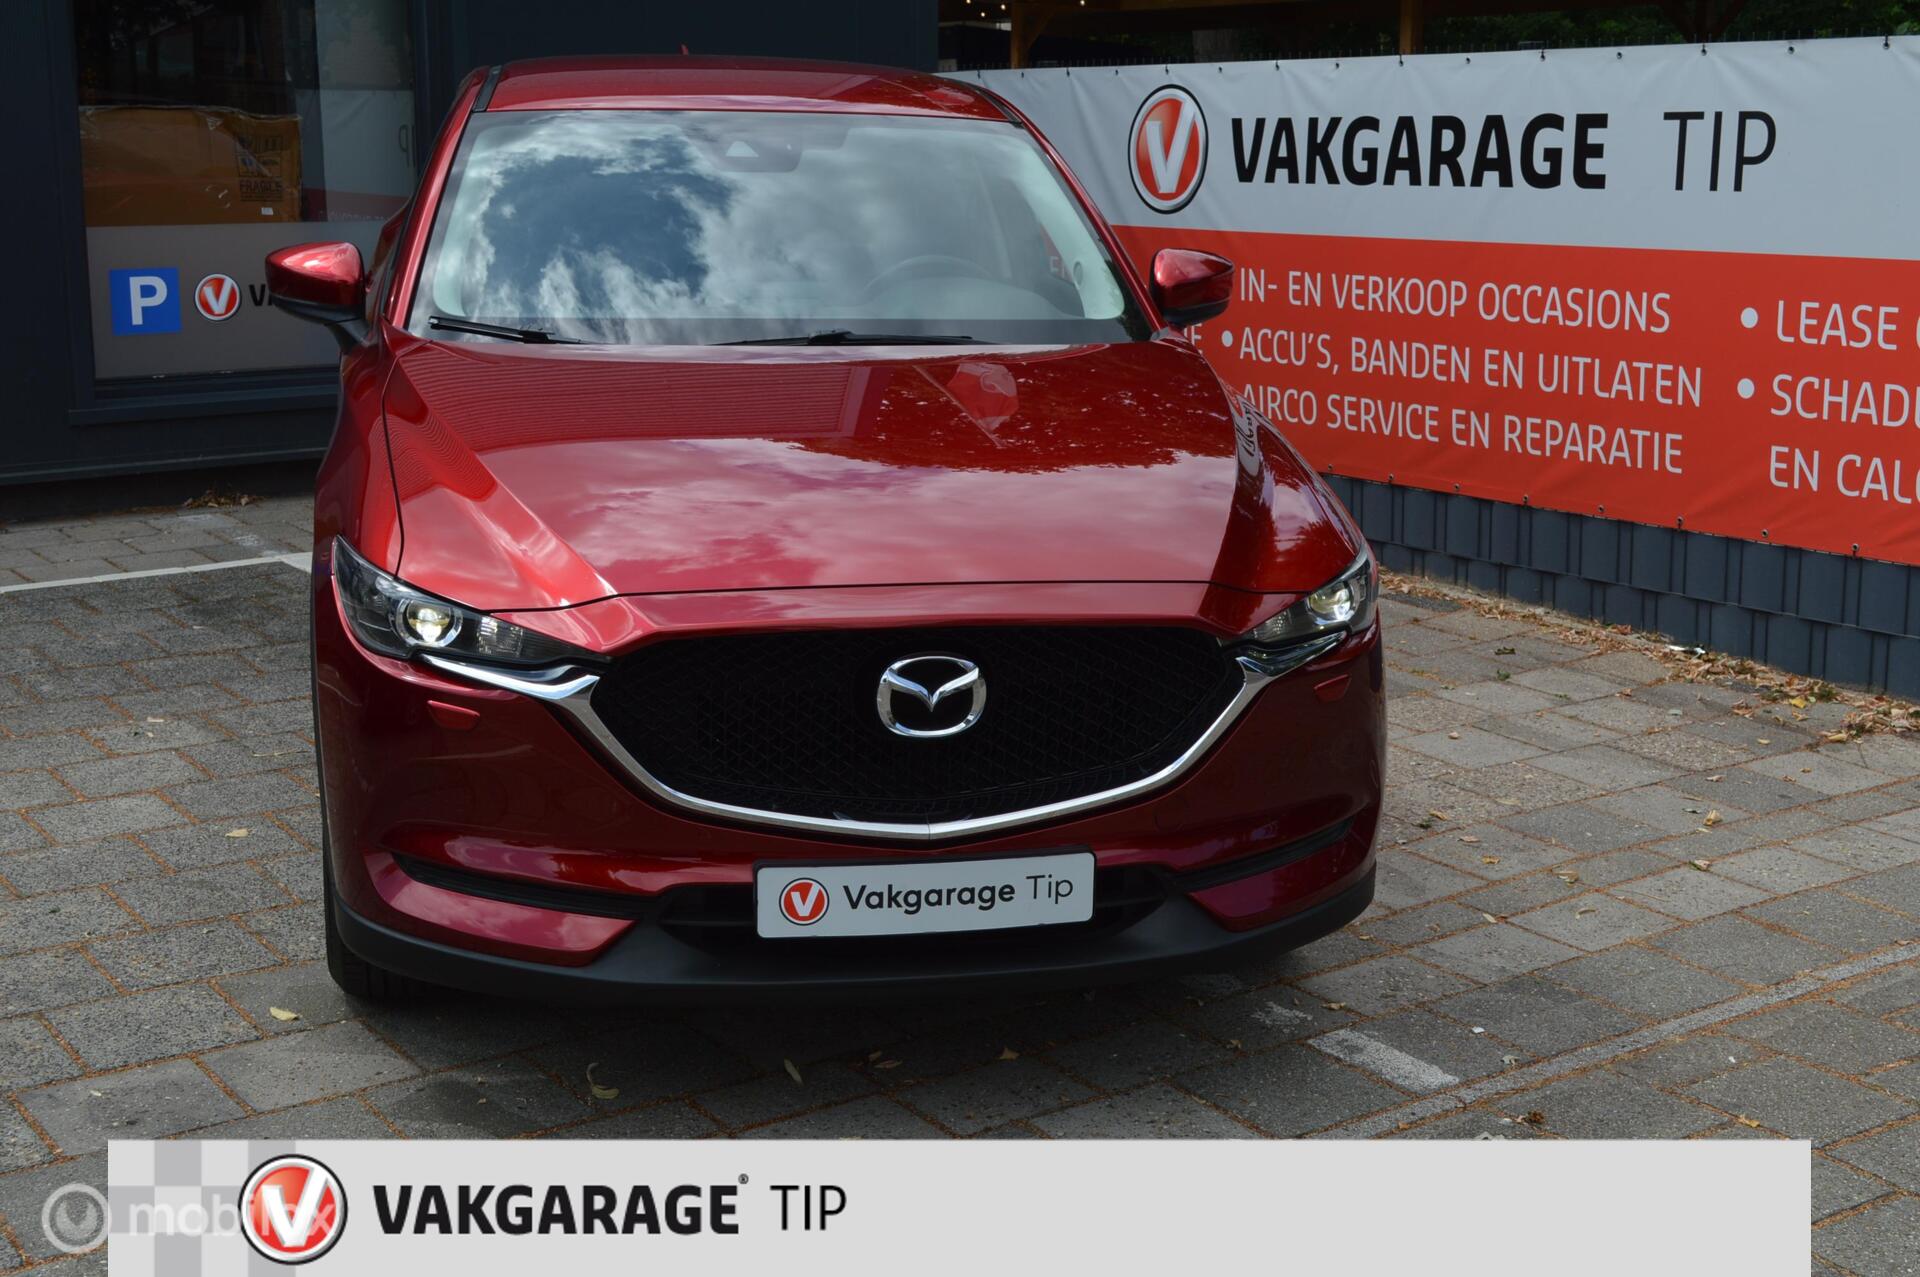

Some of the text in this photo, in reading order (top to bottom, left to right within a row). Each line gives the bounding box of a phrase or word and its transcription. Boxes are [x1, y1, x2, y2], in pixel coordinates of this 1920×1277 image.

[1231, 112, 1608, 189] VAKGARAGE
[1663, 110, 1777, 192] TIP
[129, 276, 168, 325] P
[248, 283, 272, 307] V
[1240, 268, 1671, 334] IN- EN VERKOOP OCCASIONS
[1776, 299, 1900, 351] LEASE
[1351, 336, 1470, 384] BANDEN
[1483, 348, 1524, 390] EN
[1538, 353, 1702, 408] UITLATEN
[1770, 373, 1920, 429] SCHAD
[1326, 393, 1440, 443] SERVICE
[1451, 408, 1490, 450] EN
[1504, 415, 1683, 475] REPARATIE
[1769, 445, 1920, 505] EN CAL
[843, 884, 1015, 916] Vakgarage
[1026, 874, 1073, 904] Tip
